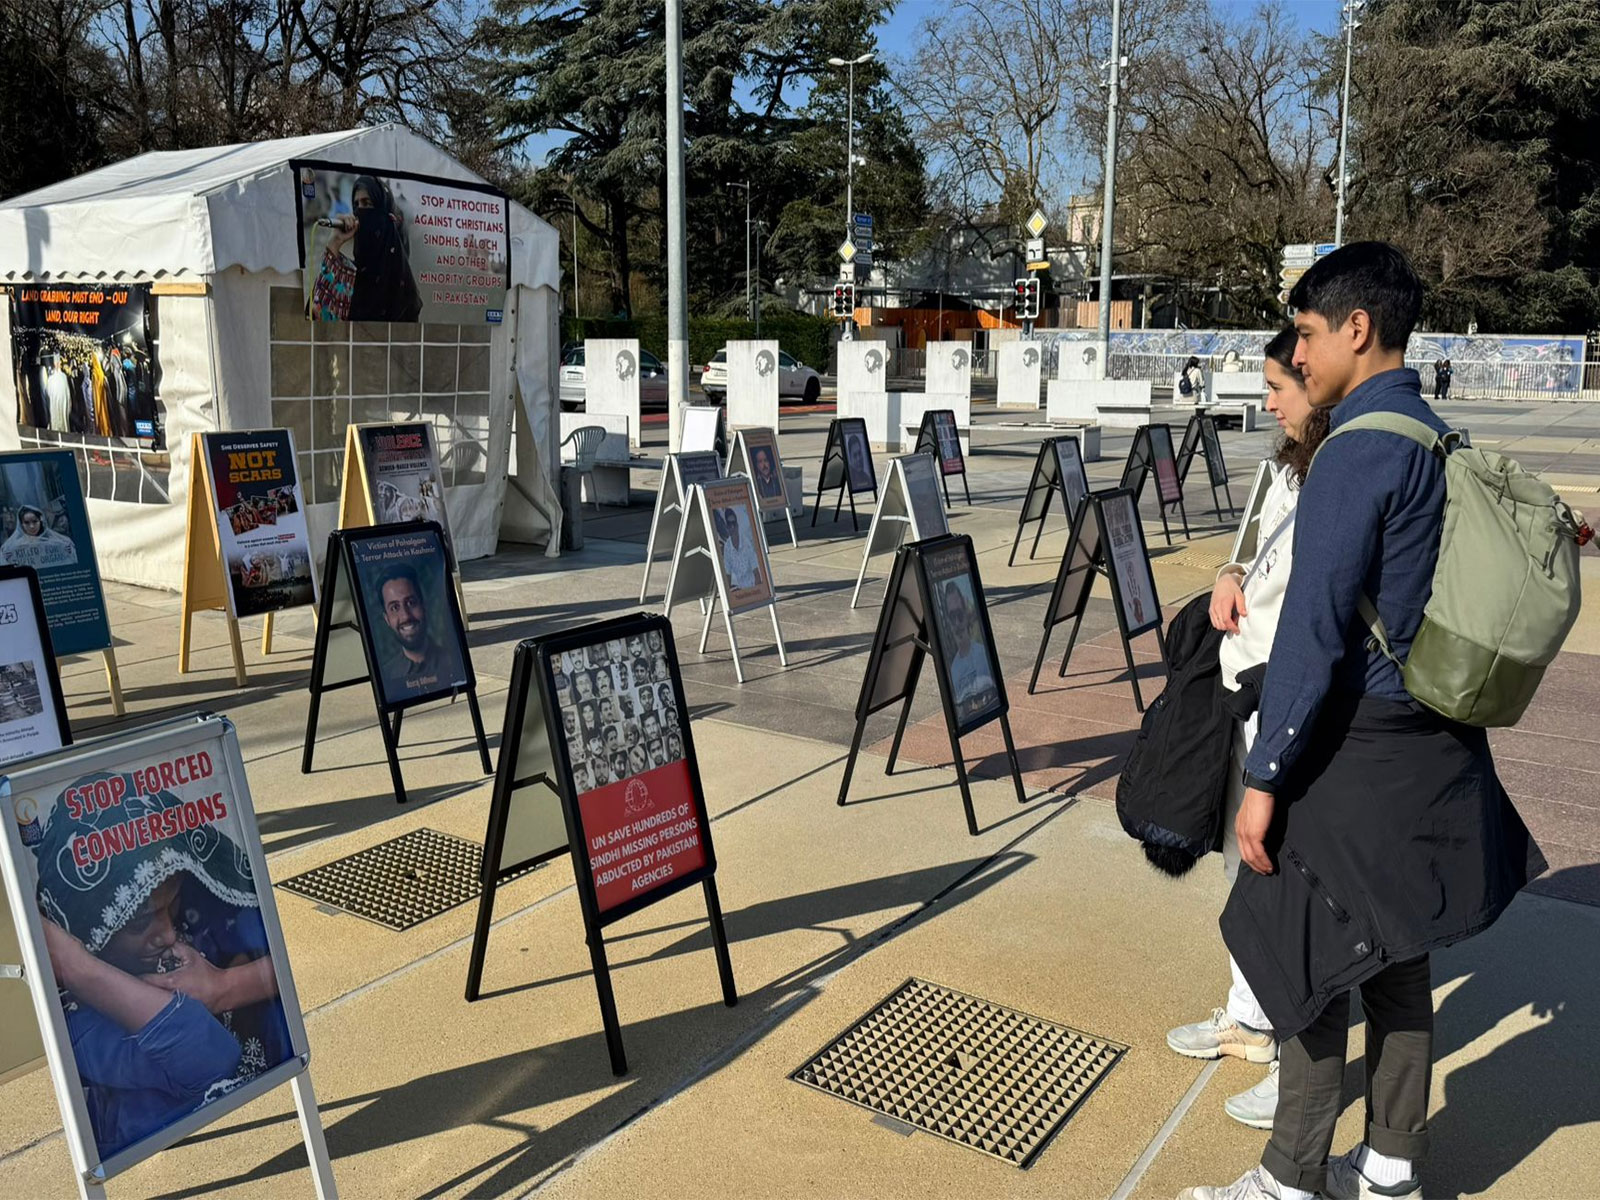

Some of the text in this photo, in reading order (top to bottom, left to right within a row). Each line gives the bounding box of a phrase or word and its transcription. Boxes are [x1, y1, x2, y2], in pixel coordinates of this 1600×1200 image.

[421, 195, 500, 214] STOP ATTROCITIES
[414, 214, 506, 234] AGAINST CHRISTIANS,
[423, 234, 498, 251] SINDHIS, BALOCH
[436, 255, 486, 268] AND OTHER
[420, 273, 501, 287] MINORITY GROUPS
[21, 290, 39, 301] LAND
[40, 291, 70, 304] GRABBING
[72, 292, 87, 303] MUST
[89, 292, 104, 304] END
[433, 292, 488, 304] IN PAKISTAN!
[63, 310, 78, 322] OUR
[79, 311, 100, 324] RIGHT
[228, 451, 277, 470] NOT
[229, 468, 283, 484] SCARS
[362, 553, 382, 562] Terror
[383, 550, 403, 559] Attack
[411, 546, 436, 555] Kashmir
[367, 541, 388, 550] Victim
[65, 751, 213, 819] STOP FORCED
[72, 791, 227, 867] CONVERSIONS
[592, 802, 689, 850] UN SAVE HUNDREDS OF
[590, 816, 698, 871] SINDHI MISSING PERSONS
[596, 834, 699, 888] ABDUCTED BY PAKISTANI
[631, 863, 673, 891] AGENCIES
